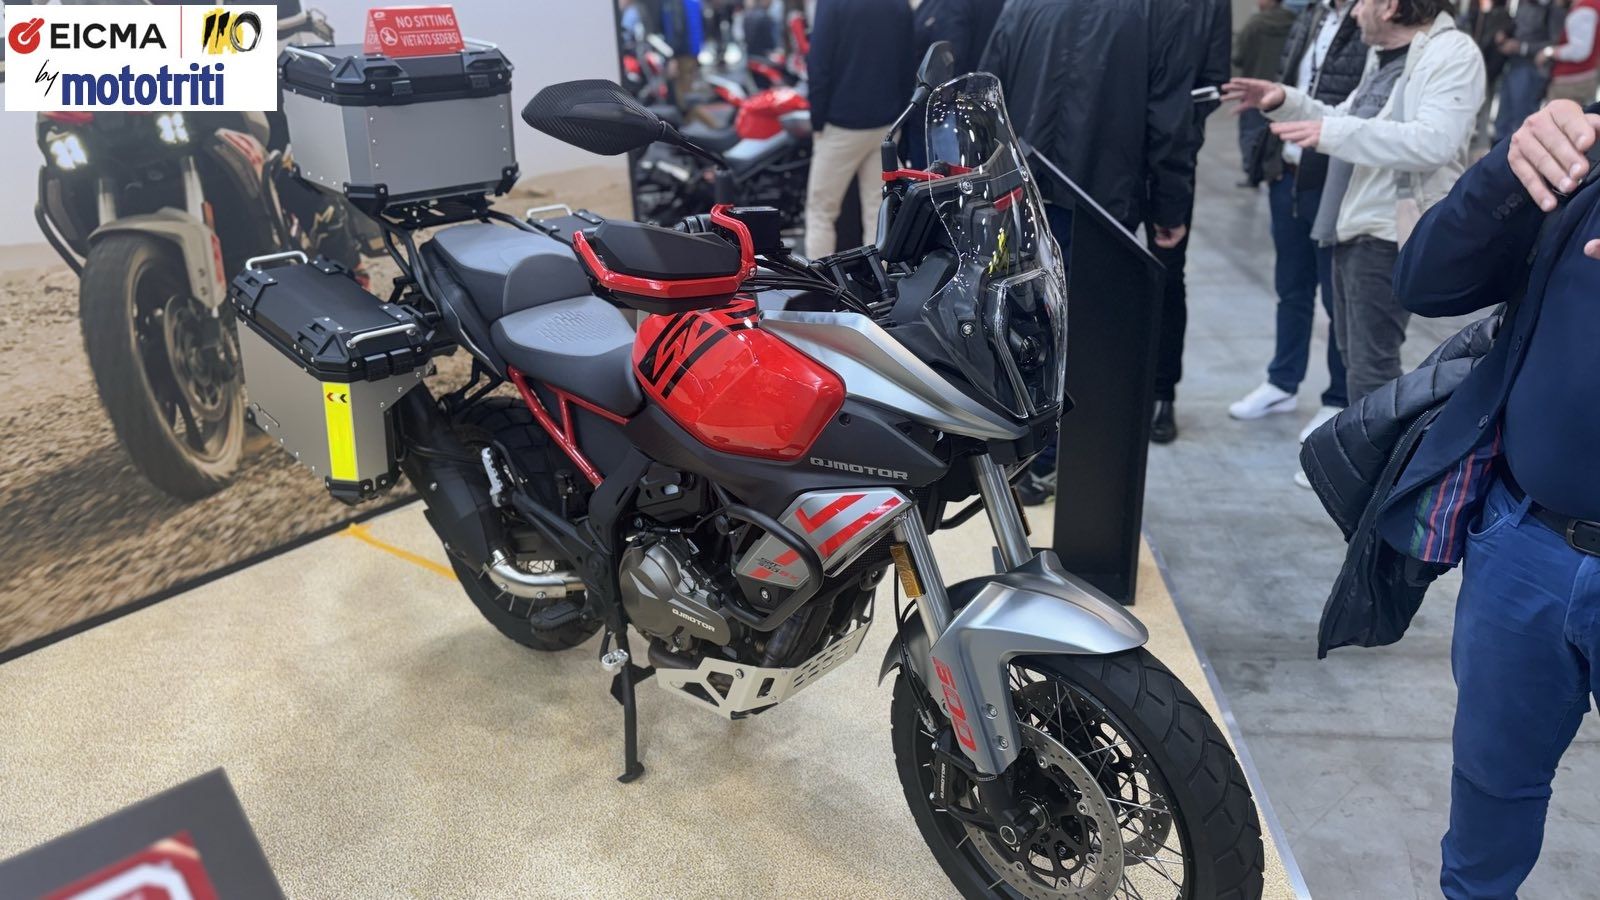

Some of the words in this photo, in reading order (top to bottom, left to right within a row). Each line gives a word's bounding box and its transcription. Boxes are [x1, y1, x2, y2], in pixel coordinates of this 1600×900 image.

[395, 15, 413, 29] NO
[414, 14, 454, 28] SITTING
[400, 33, 432, 47] VIETATO
[432, 32, 460, 46] SEDERSI
[810, 457, 908, 480] QJMOTOR
[671, 608, 716, 633] QJMOTOR
[931, 656, 977, 752] 500
